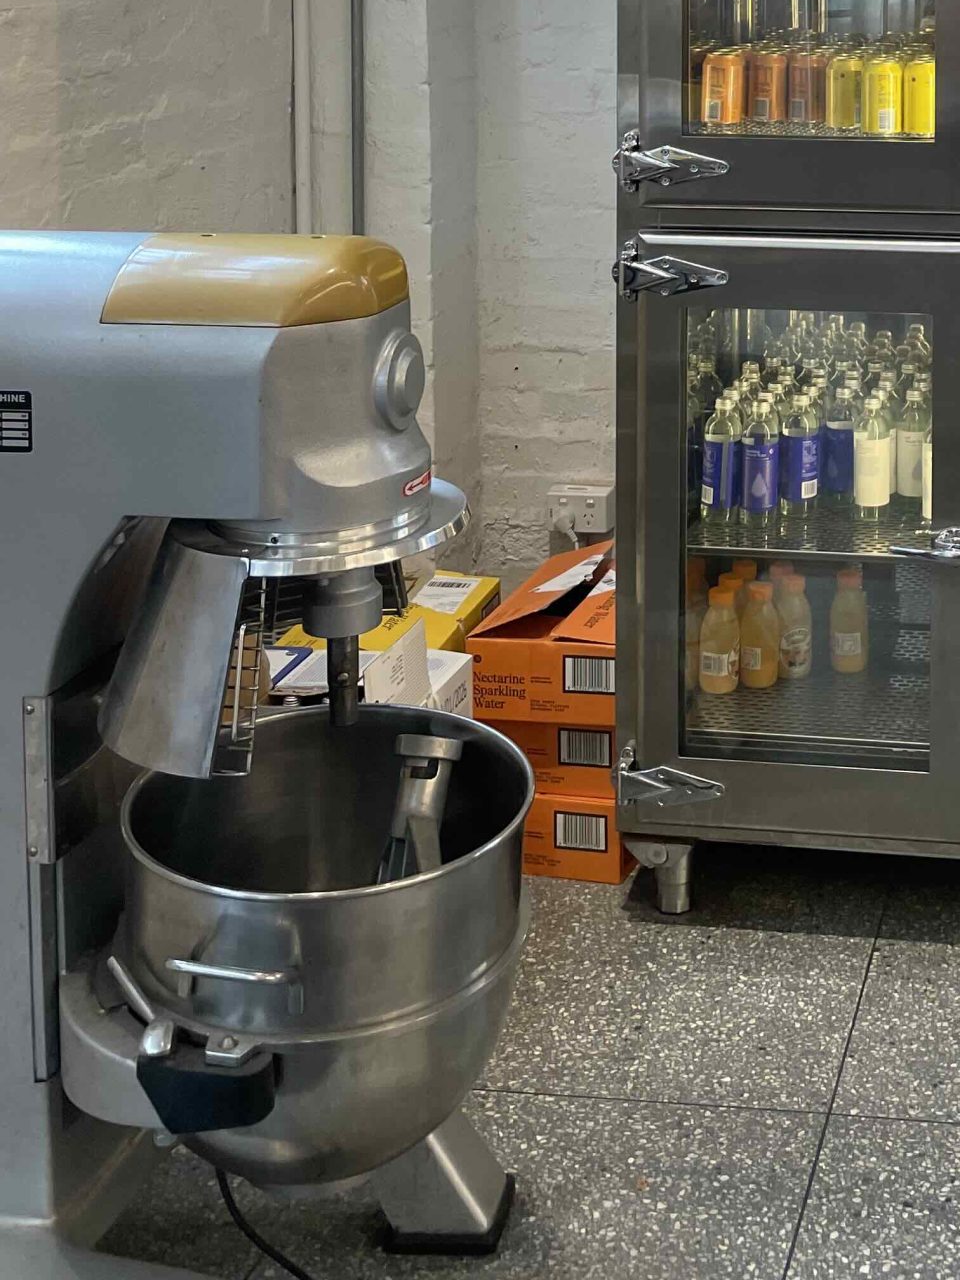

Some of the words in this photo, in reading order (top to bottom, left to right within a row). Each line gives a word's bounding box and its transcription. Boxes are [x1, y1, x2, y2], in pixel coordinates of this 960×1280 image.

[473, 671, 525, 684] Nectarine
[473, 684, 526, 700] Sparkling
[473, 697, 506, 709] Water
